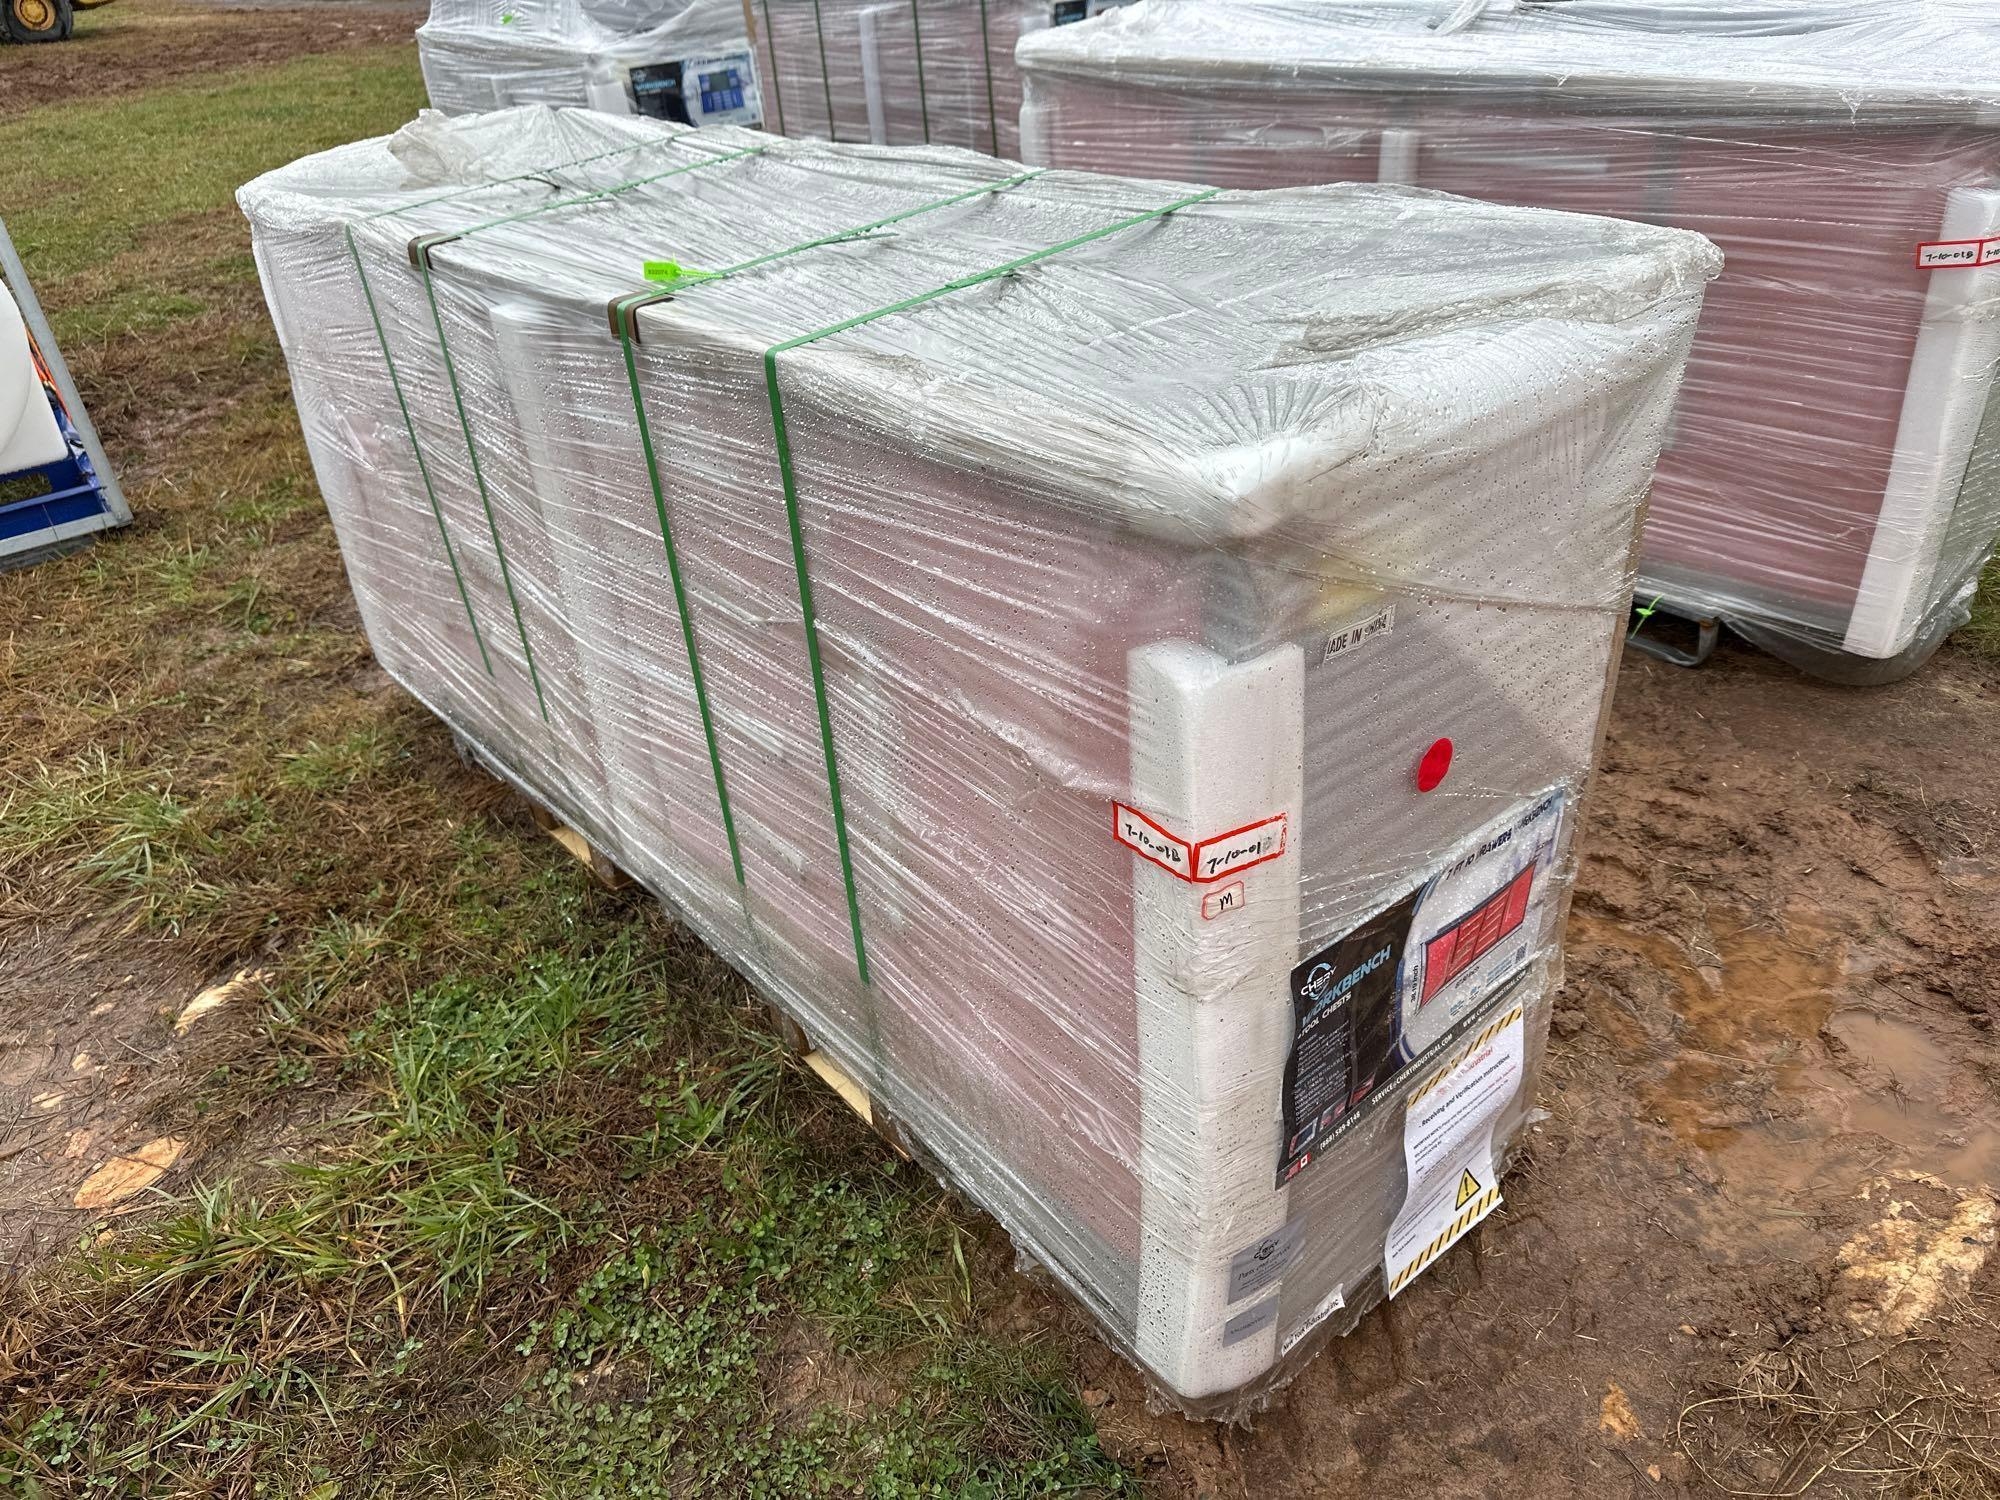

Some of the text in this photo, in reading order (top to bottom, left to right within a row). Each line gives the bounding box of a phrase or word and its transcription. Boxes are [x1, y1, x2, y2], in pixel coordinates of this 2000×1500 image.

[1351, 627, 1363, 645] IN
[1301, 966, 1337, 996] CHERY
[1321, 991, 1352, 1019] CHESTS
[1445, 1095, 1456, 1108] and
